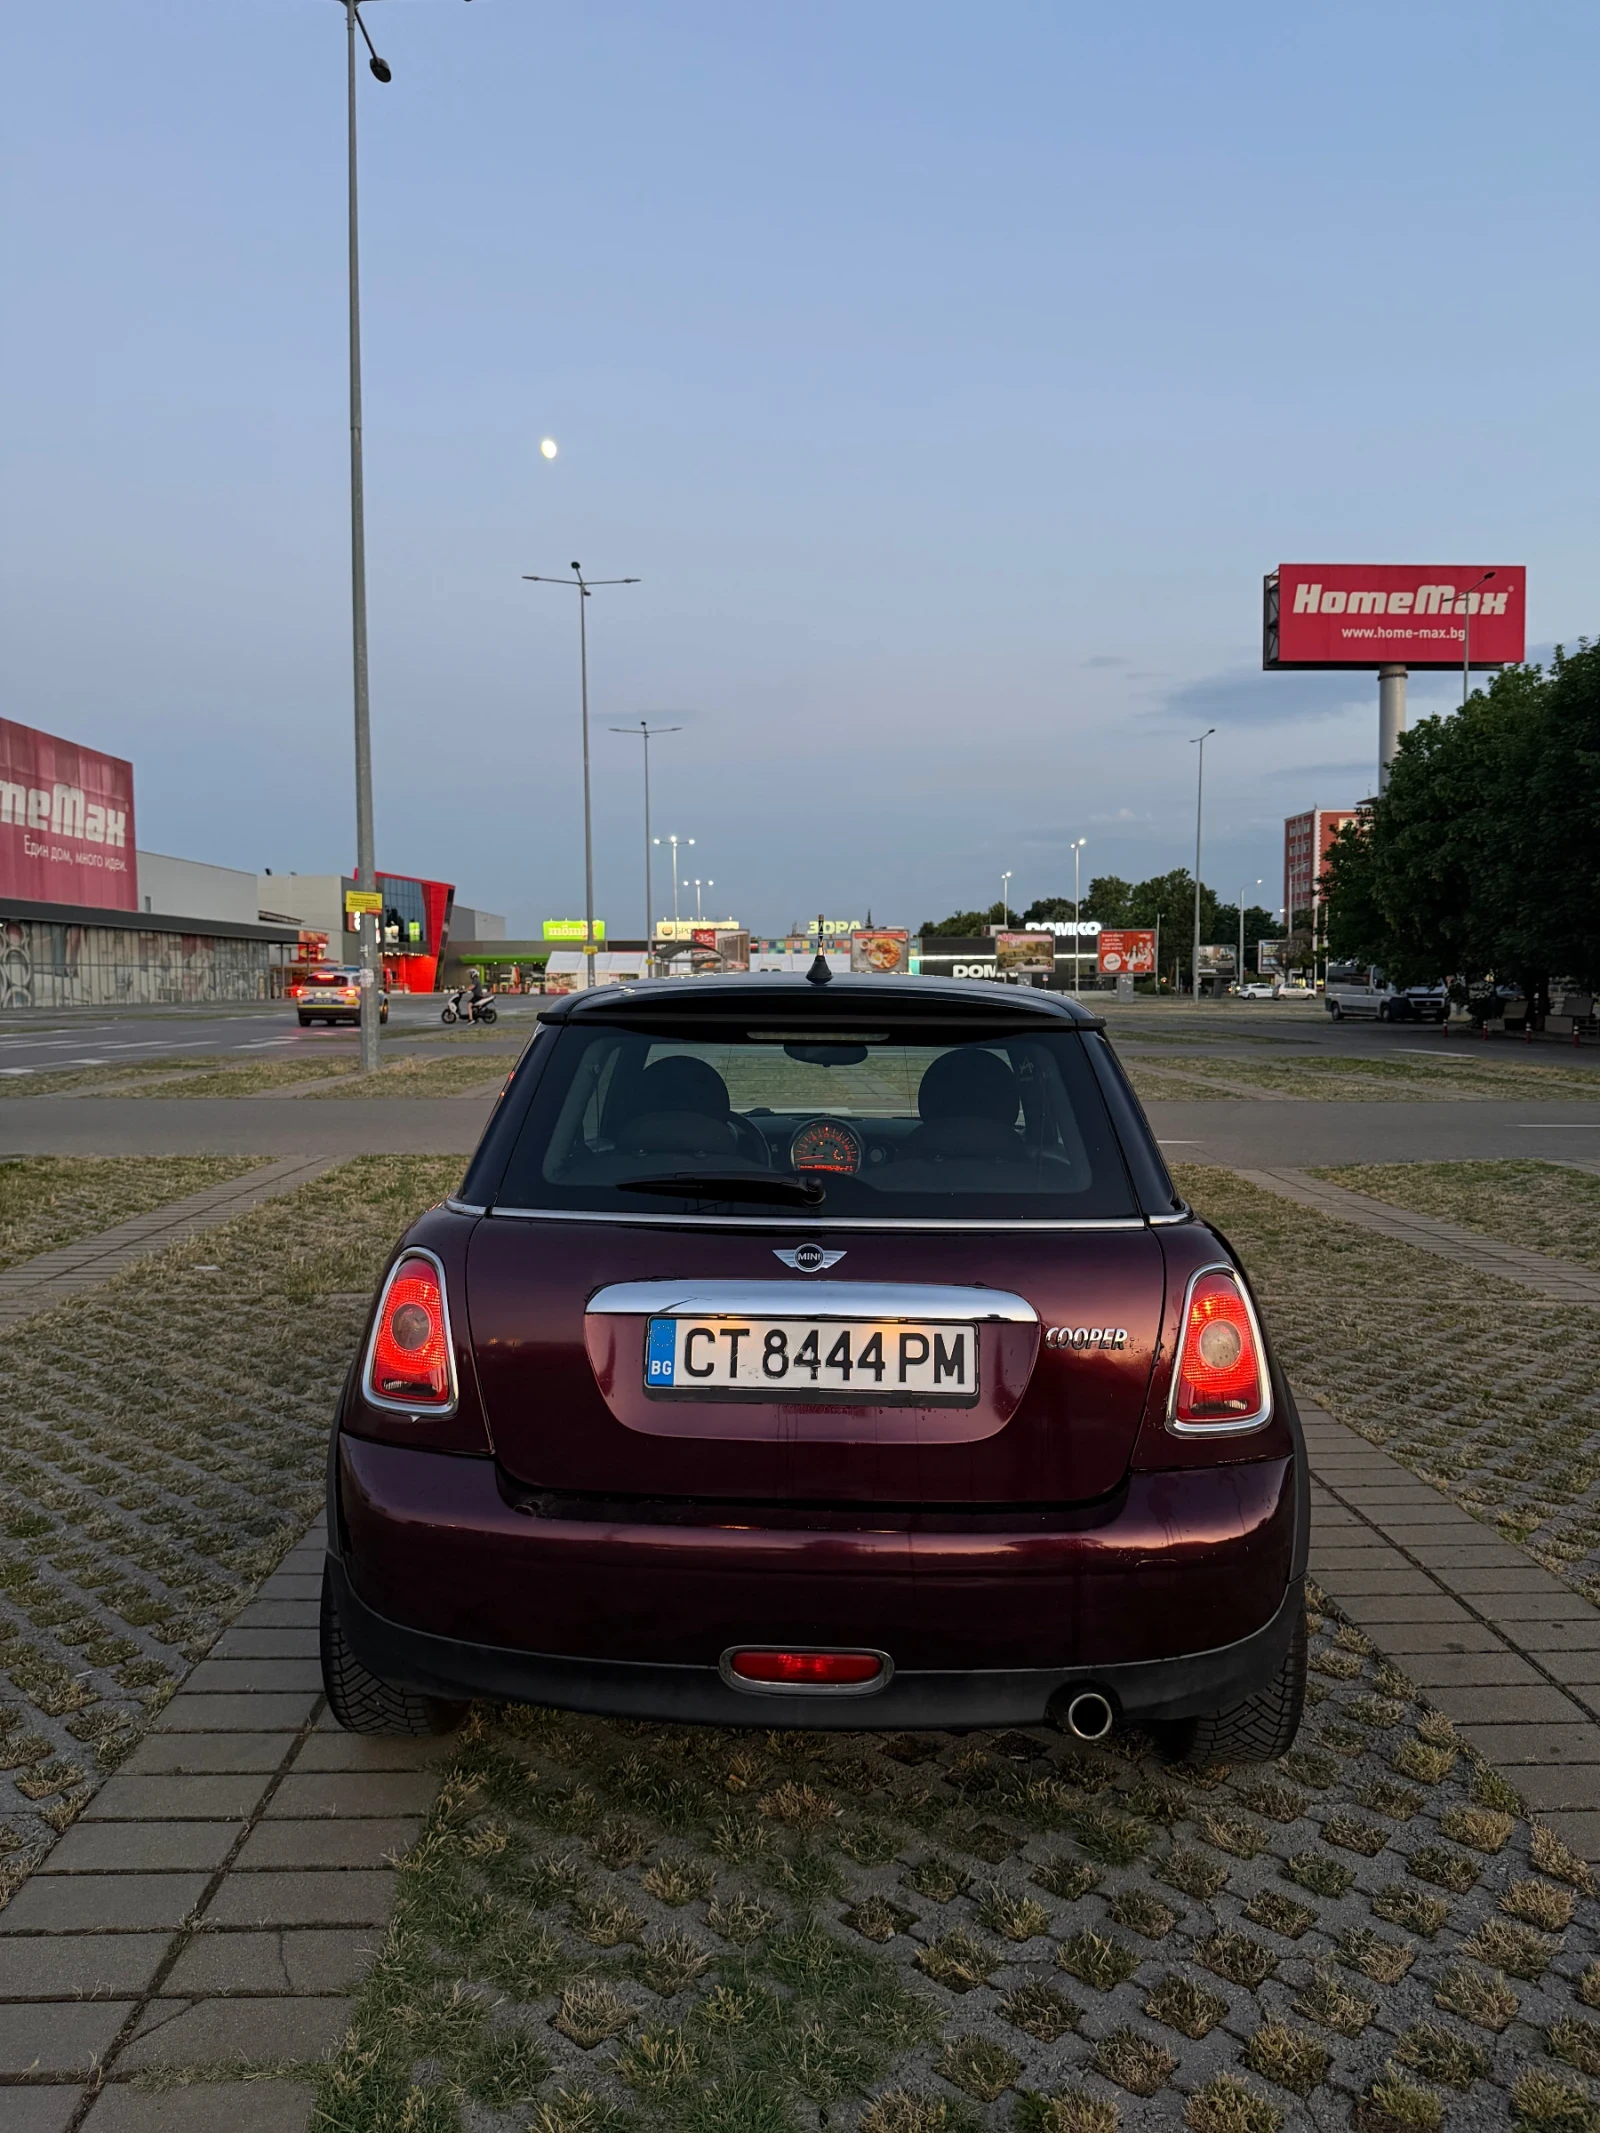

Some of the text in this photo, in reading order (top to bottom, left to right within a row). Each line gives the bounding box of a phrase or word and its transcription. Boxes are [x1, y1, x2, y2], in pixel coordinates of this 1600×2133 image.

[1292, 583, 1509, 615] HomeMax
[1341, 626, 1466, 642] www.home-max.bg
[24, 834, 49, 859] Един
[51, 846, 73, 865] дом,
[75, 852, 104, 868] много
[952, 964, 1019, 978] DOM
[798, 1252, 821, 1261] MINI
[1045, 1326, 1128, 1350] COOPER
[684, 1327, 965, 1385] CT 8444 PM
[651, 1360, 672, 1376] BG
